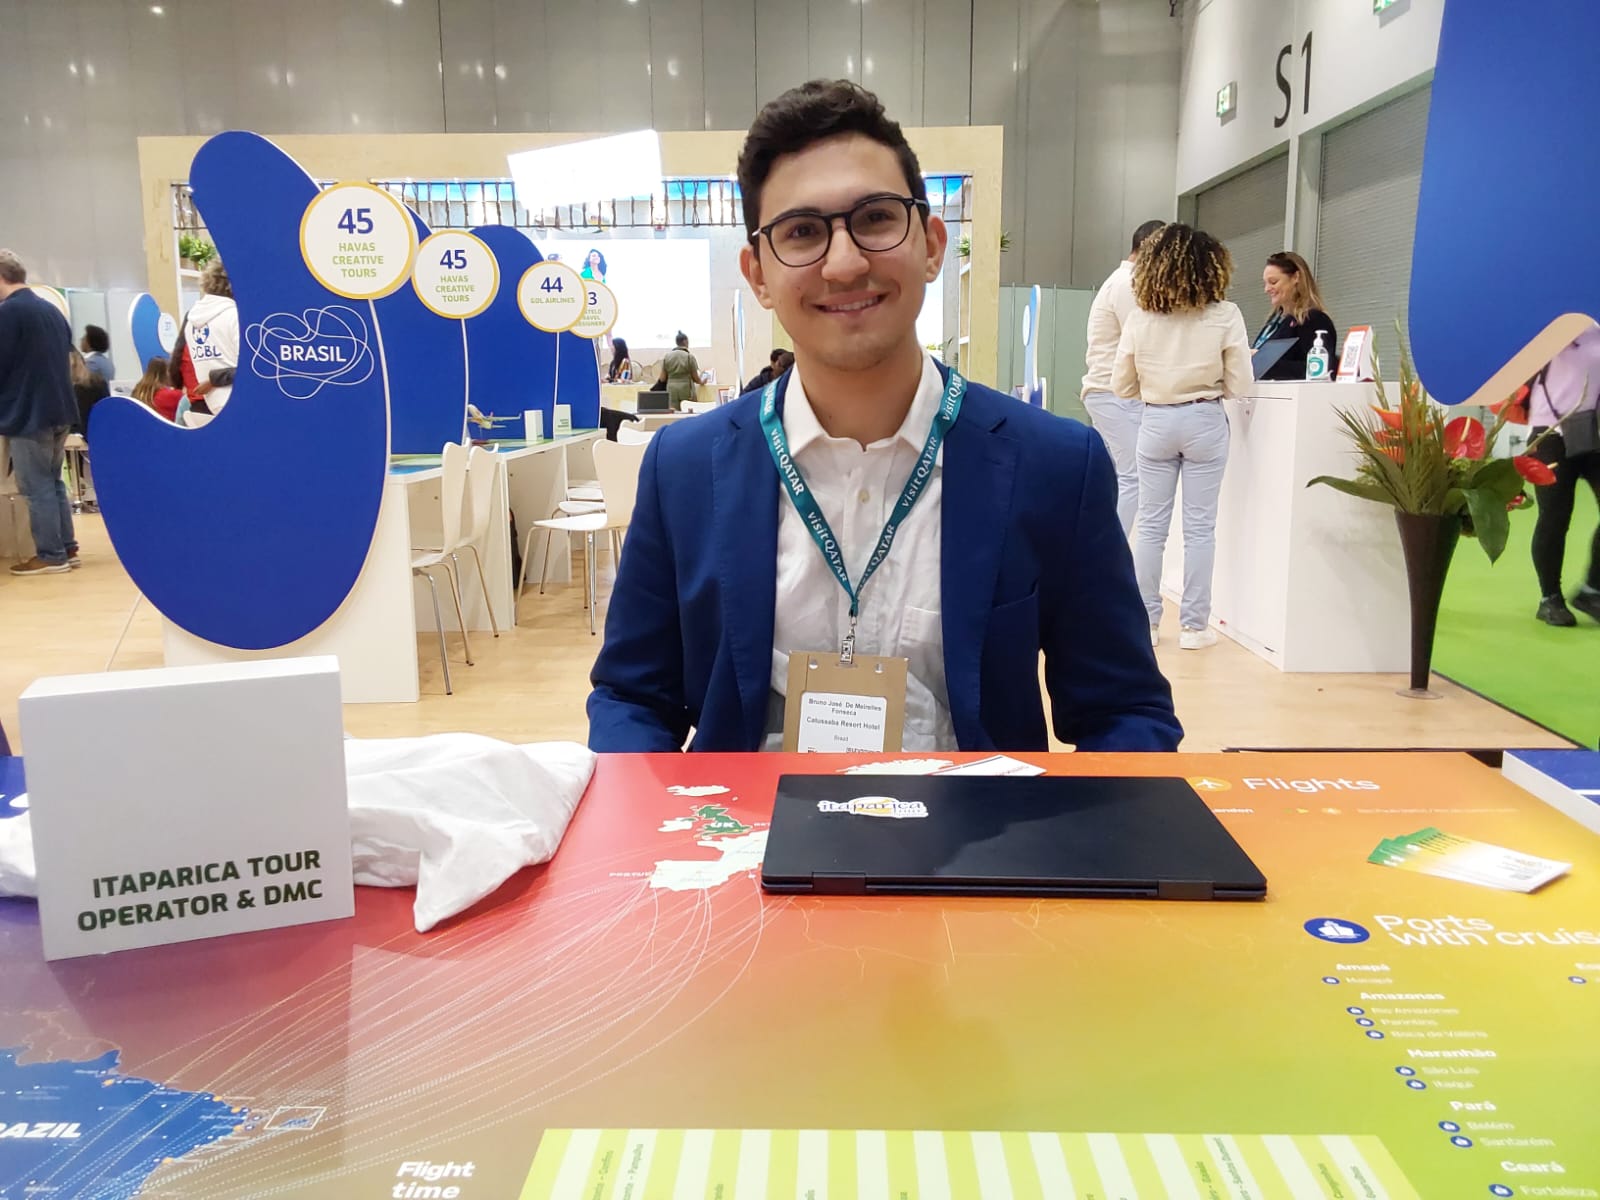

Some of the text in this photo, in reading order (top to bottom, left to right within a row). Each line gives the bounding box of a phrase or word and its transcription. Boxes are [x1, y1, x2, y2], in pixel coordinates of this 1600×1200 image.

[1274, 30, 1313, 129] S1
[337, 208, 374, 235] 45
[338, 242, 376, 252] HAVAS
[332, 256, 384, 265] CREATIVE
[439, 249, 467, 270] 45
[341, 269, 377, 278] TOURS
[440, 275, 469, 283] HAVAS
[435, 285, 475, 293] CREATIVE
[540, 276, 564, 293] 44
[442, 295, 470, 303] TOURS
[588, 291, 597, 306] 3
[280, 344, 347, 362] BRASIL
[770, 427, 805, 496] visitQATAR
[902, 436, 938, 508] visitQATAR
[807, 511, 848, 583] visitQATAR
[840, 720, 862, 729] Resort
[1242, 777, 1380, 793] Flights
[820, 798, 923, 814] itaparica
[93, 849, 321, 899] ITAPARICA TOUR
[77, 879, 323, 932] OPERATOR & DMC
[1373, 914, 1495, 932] Ports
[1388, 927, 1600, 946] with cruis
[1360, 992, 1446, 1000] Amazonas
[1449, 1100, 1497, 1112] Pará
[0, 1122, 82, 1138] AZIL
[396, 1161, 476, 1181] Flight
[1500, 1160, 1567, 1174] Ceará
[392, 1183, 460, 1199] time
